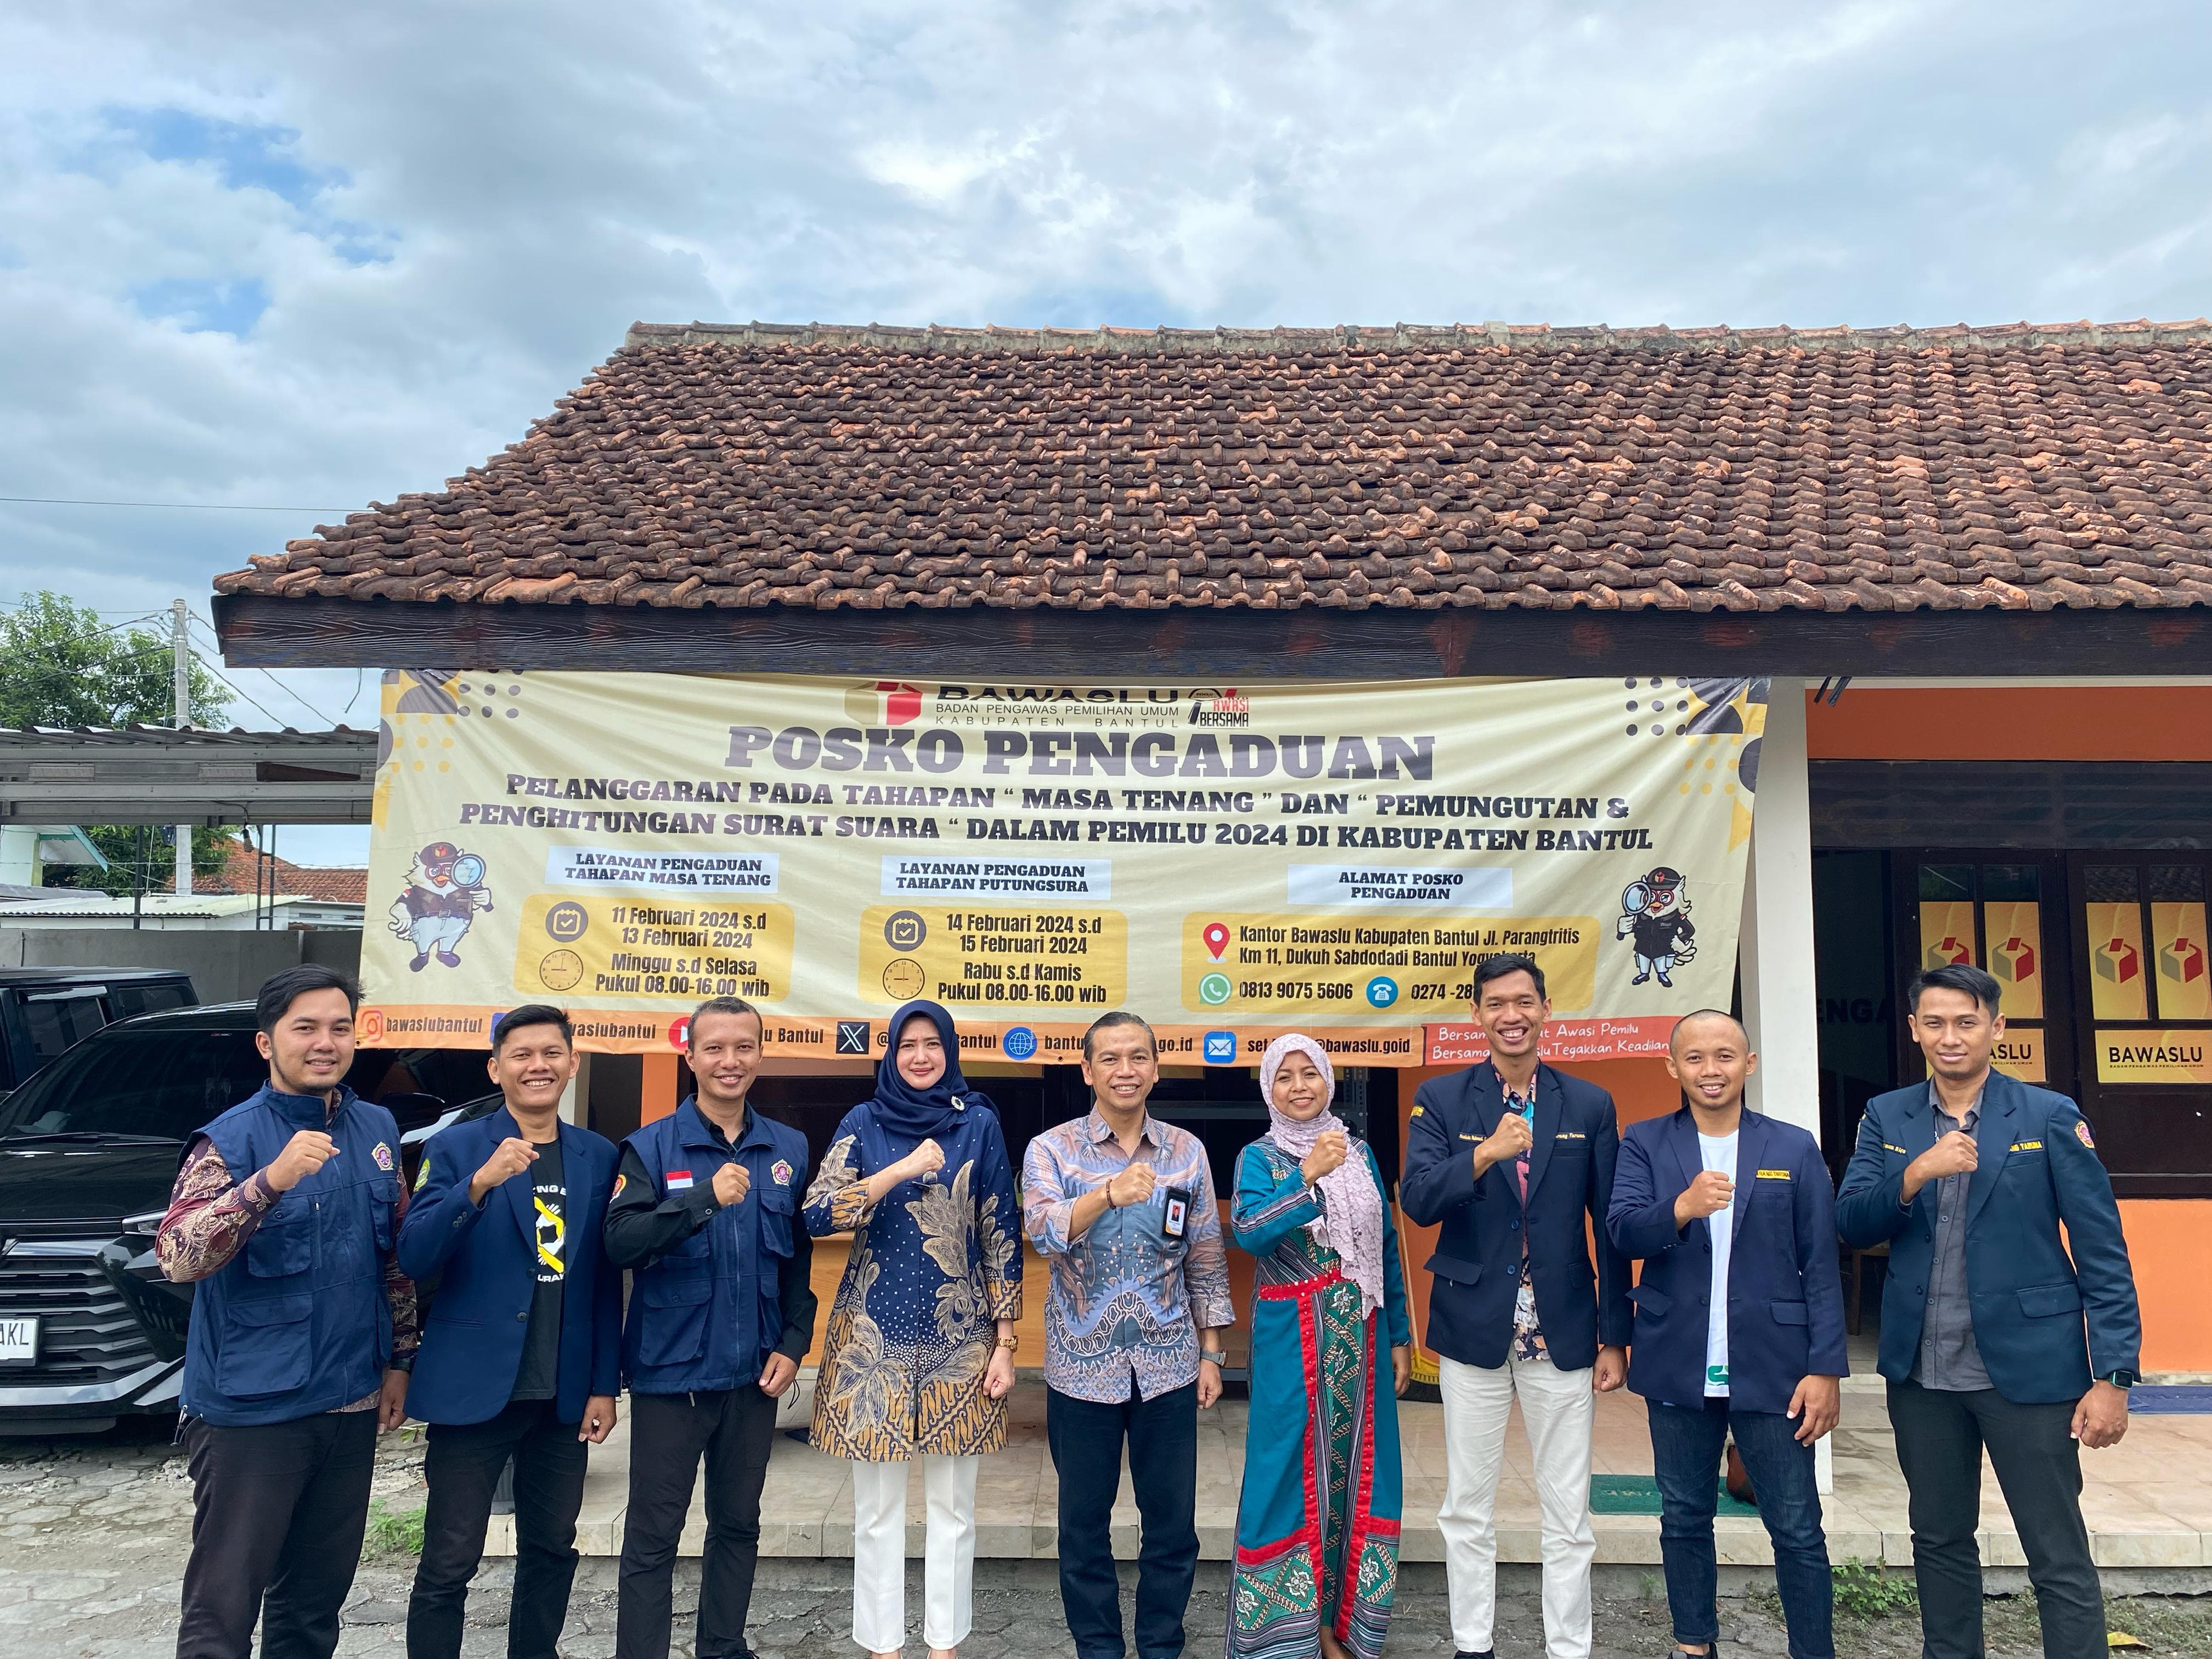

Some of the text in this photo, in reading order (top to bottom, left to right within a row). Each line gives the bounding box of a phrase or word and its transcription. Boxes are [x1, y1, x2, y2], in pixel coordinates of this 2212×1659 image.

[937, 686, 1178, 703] BAWASLU
[936, 704, 1178, 716] BADAN PENGAWAS PEMILIHAN UMUM
[1213, 700, 1249, 712] AWASI
[936, 716, 1178, 727] KABUPATEN BANTUL
[1200, 712, 1249, 727] BERSAMA
[725, 726, 1435, 780] POSKO PENGADUAN
[506, 774, 741, 802] PELANGGARAN
[749, 782, 833, 804] PADA
[843, 785, 995, 808] TAHAPAN
[1022, 789, 1113, 810] MASA
[1122, 790, 1254, 812] TENANG
[1281, 793, 1348, 814] DAN
[1376, 795, 1598, 818] PEMUNGUTAN
[1607, 798, 1629, 818] &
[460, 804, 716, 834] PENGHITUNGAN
[724, 814, 828, 836] SURAT
[836, 816, 939, 838] SUARA
[967, 819, 1079, 841] DALAM
[1088, 821, 1206, 843] PEMILU
[1215, 823, 1288, 845] 2024
[1296, 826, 1329, 847] DI
[1338, 826, 1529, 850] KABUPATEN
[1536, 829, 1652, 850] BANTUL
[576, 854, 761, 871] LAYANAN PENGADUAN
[900, 863, 1085, 877] LAYANAN PENGADUAN
[565, 868, 771, 885] TAHAPAN MASA TENANG
[896, 877, 1088, 891] TAHAPAN PUTUNGSURA
[1339, 872, 1463, 885] ALAMAT POSKO
[1351, 887, 1450, 899] PENGADUAN
[612, 907, 766, 929] 11 Februari 2024 s.d
[947, 914, 1101, 933] 14 Februari 2024 s.d
[623, 927, 752, 949] 13 Februari 2024
[960, 935, 1087, 954] 15 Februari 2024
[1240, 926, 1579, 946] Kantor Bawaslu Kabupaten Bantul Jl. Parangtritis
[611, 953, 757, 975] Minggu s.d Selasa
[1239, 947, 1262, 964] Km
[1265, 948, 1282, 968] 11,
[1286, 948, 1330, 966] Dukuh
[1334, 949, 1408, 966] Sabdodadi
[1412, 950, 1457, 967] Bantul
[964, 962, 1081, 981] Rabu s.d Kamis
[596, 974, 769, 996] Pukul 08.00-16.00 wib
[939, 983, 1106, 1002] Pukul 08.00-16.00 wib
[1240, 981, 1352, 999] 0813 9075 5606
[1411, 984, 1474, 1000] 0274 -28
[386, 1017, 483, 1032] bawaslubantul
[1438, 1027, 1487, 1041] Bersam
[1556, 1024, 1595, 1038] Awasi
[1601, 1023, 1639, 1036] Pemilu
[778, 1028, 823, 1043] Bantul
[1432, 1046, 1491, 1059] Bersama
[1551, 1042, 1612, 1059] Tegakkan
[1617, 1039, 1669, 1053] Keadilan
[1989, 1044, 2032, 1059] ASLU
[2109, 1047, 2202, 1062] BAWASLU
